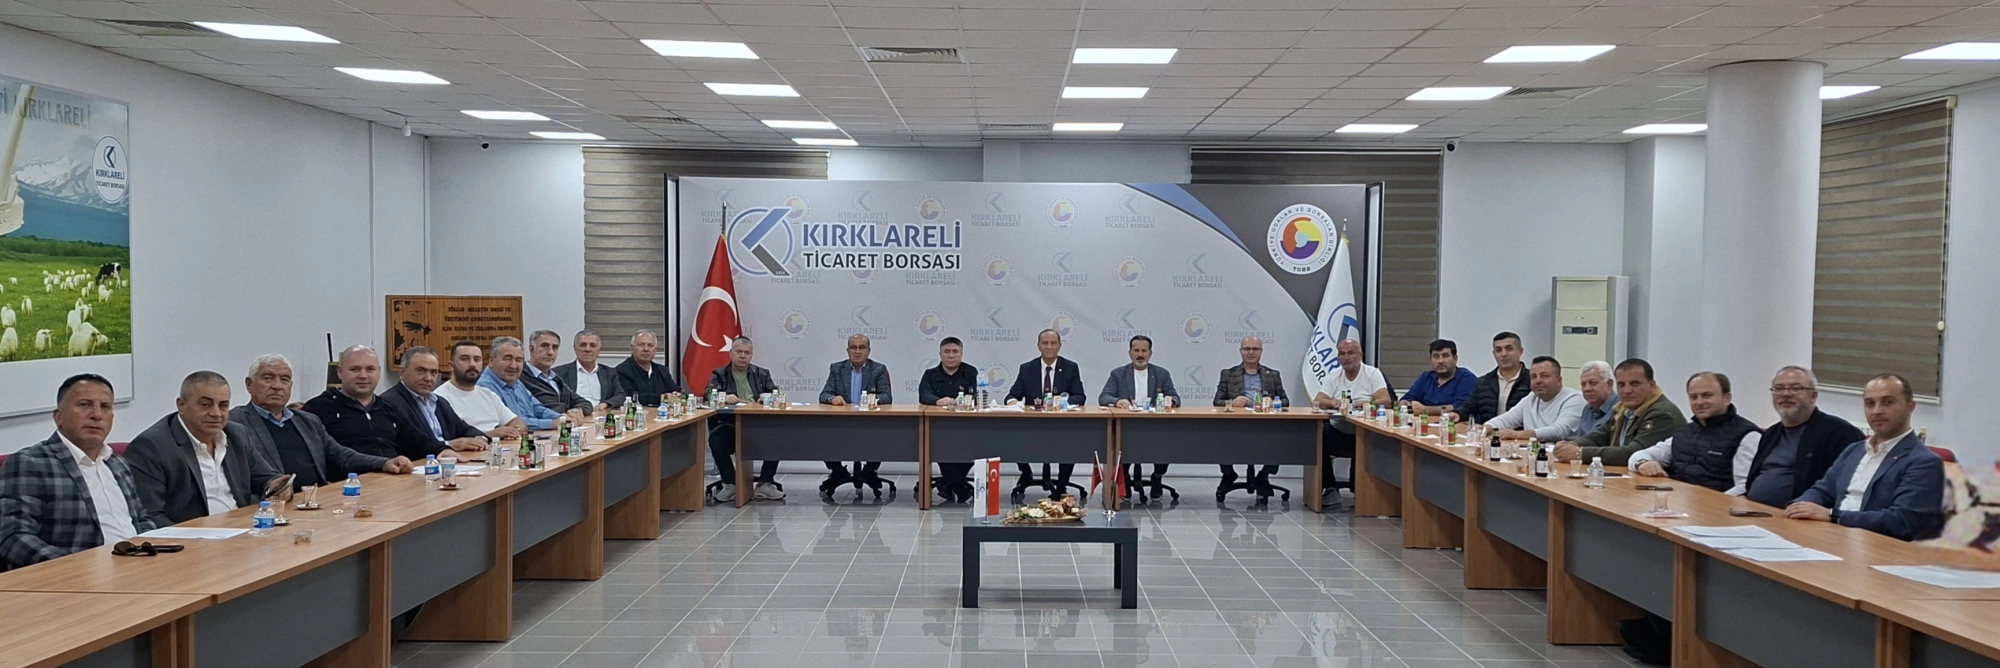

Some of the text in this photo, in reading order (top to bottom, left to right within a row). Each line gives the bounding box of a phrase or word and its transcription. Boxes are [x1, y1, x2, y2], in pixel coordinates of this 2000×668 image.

[96, 168, 125, 180] KIRKLARELİ
[1272, 209, 1293, 232] ODALAR
[1307, 207, 1334, 237] BORSALAR
[803, 221, 961, 248] KIRKLARELİ
[803, 250, 960, 269] TİCARET BORSASI
